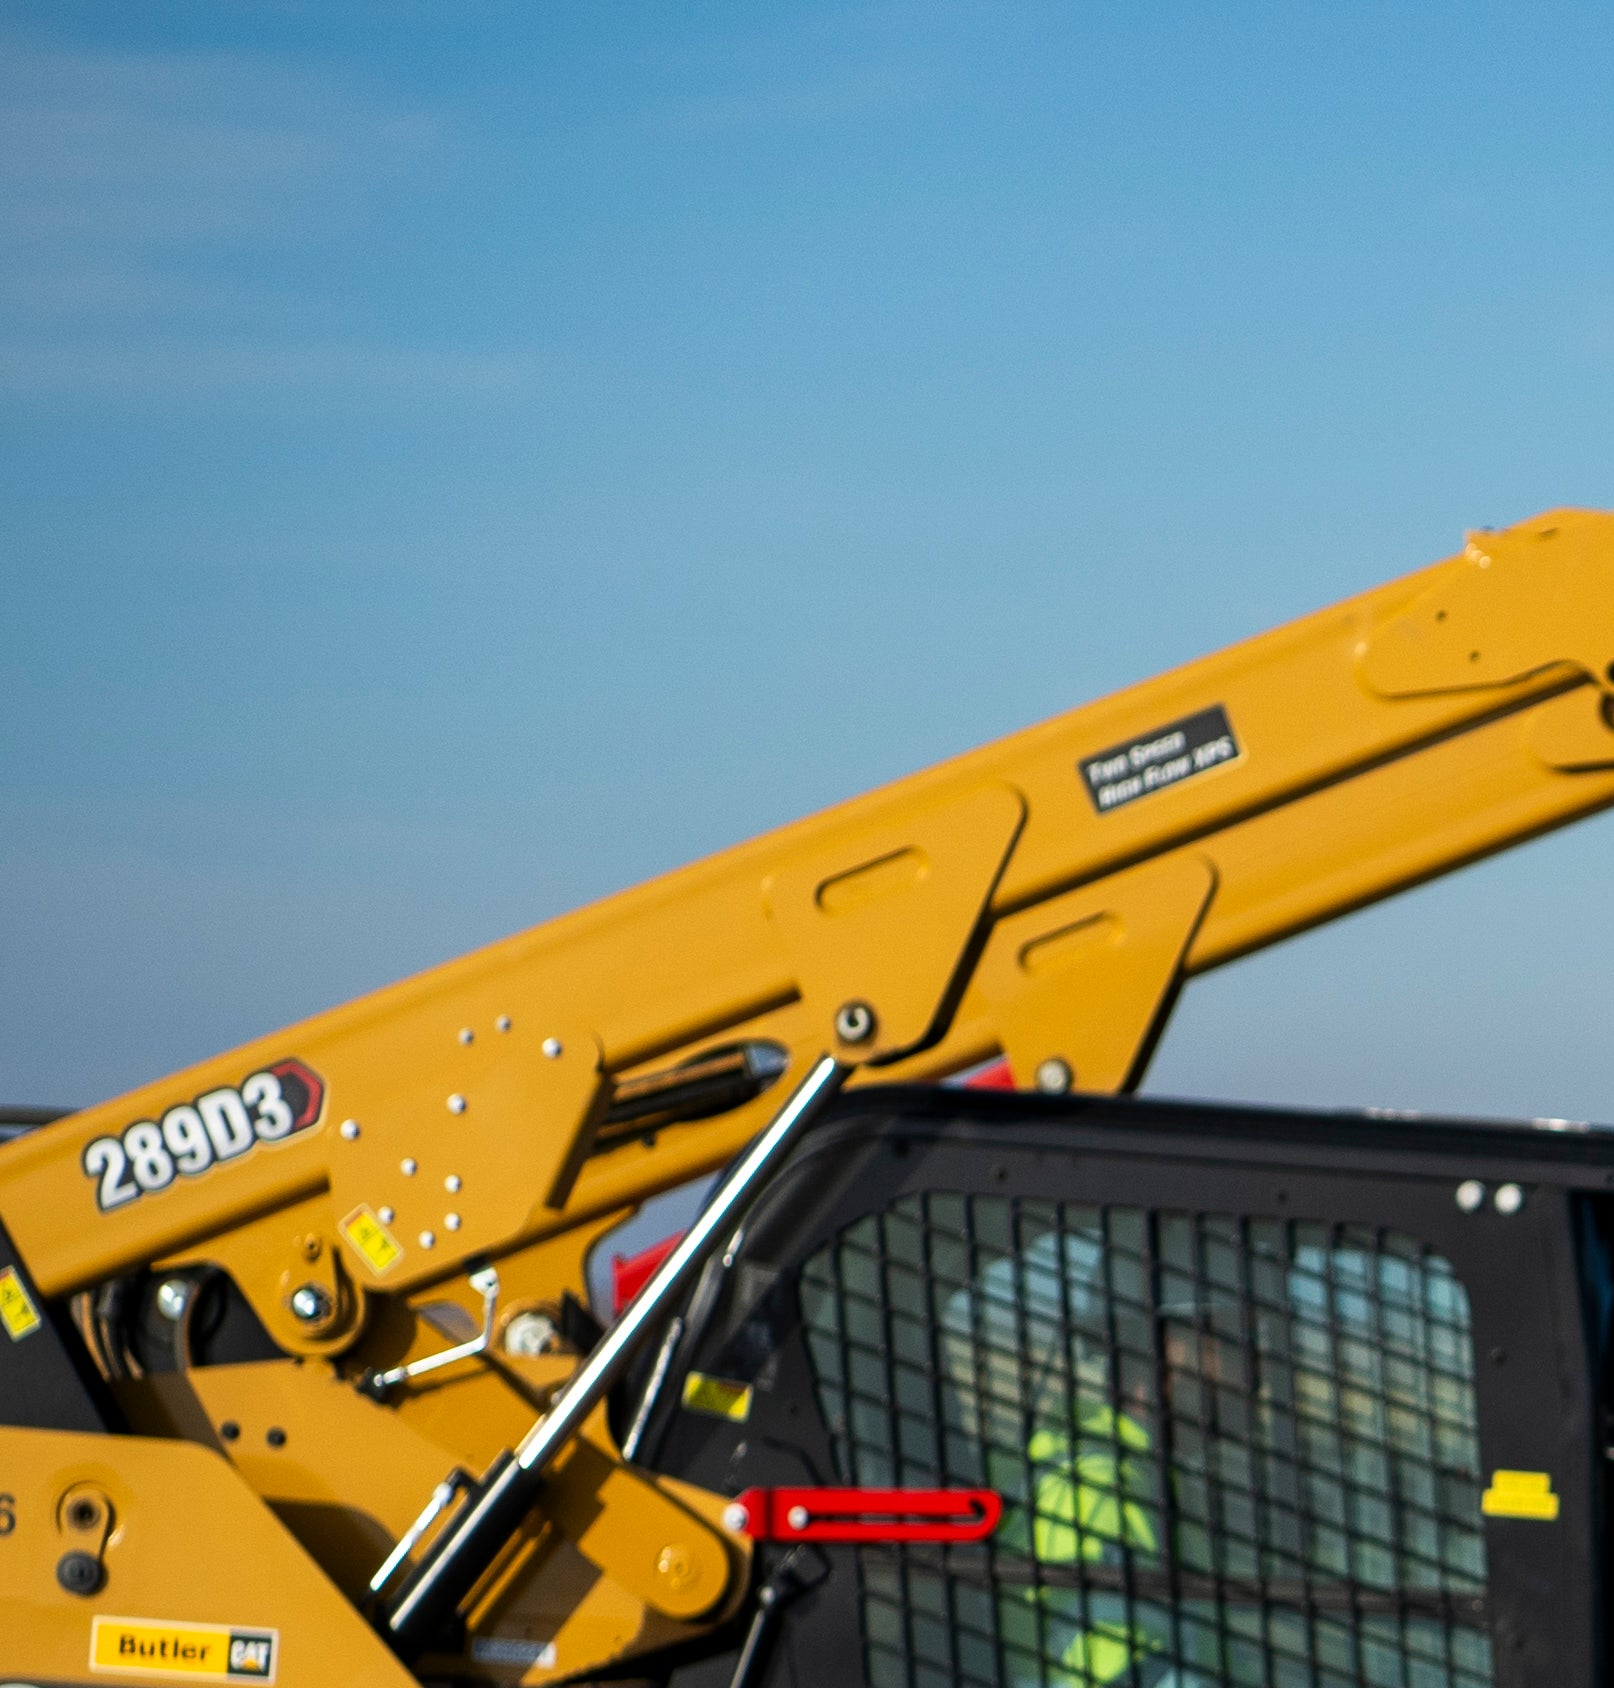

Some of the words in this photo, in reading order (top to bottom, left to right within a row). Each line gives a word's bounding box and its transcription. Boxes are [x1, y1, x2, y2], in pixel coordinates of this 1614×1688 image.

[85, 1071, 293, 1210] 289D3
[119, 1634, 211, 1661] Butler
[230, 1638, 270, 1672] CAT
